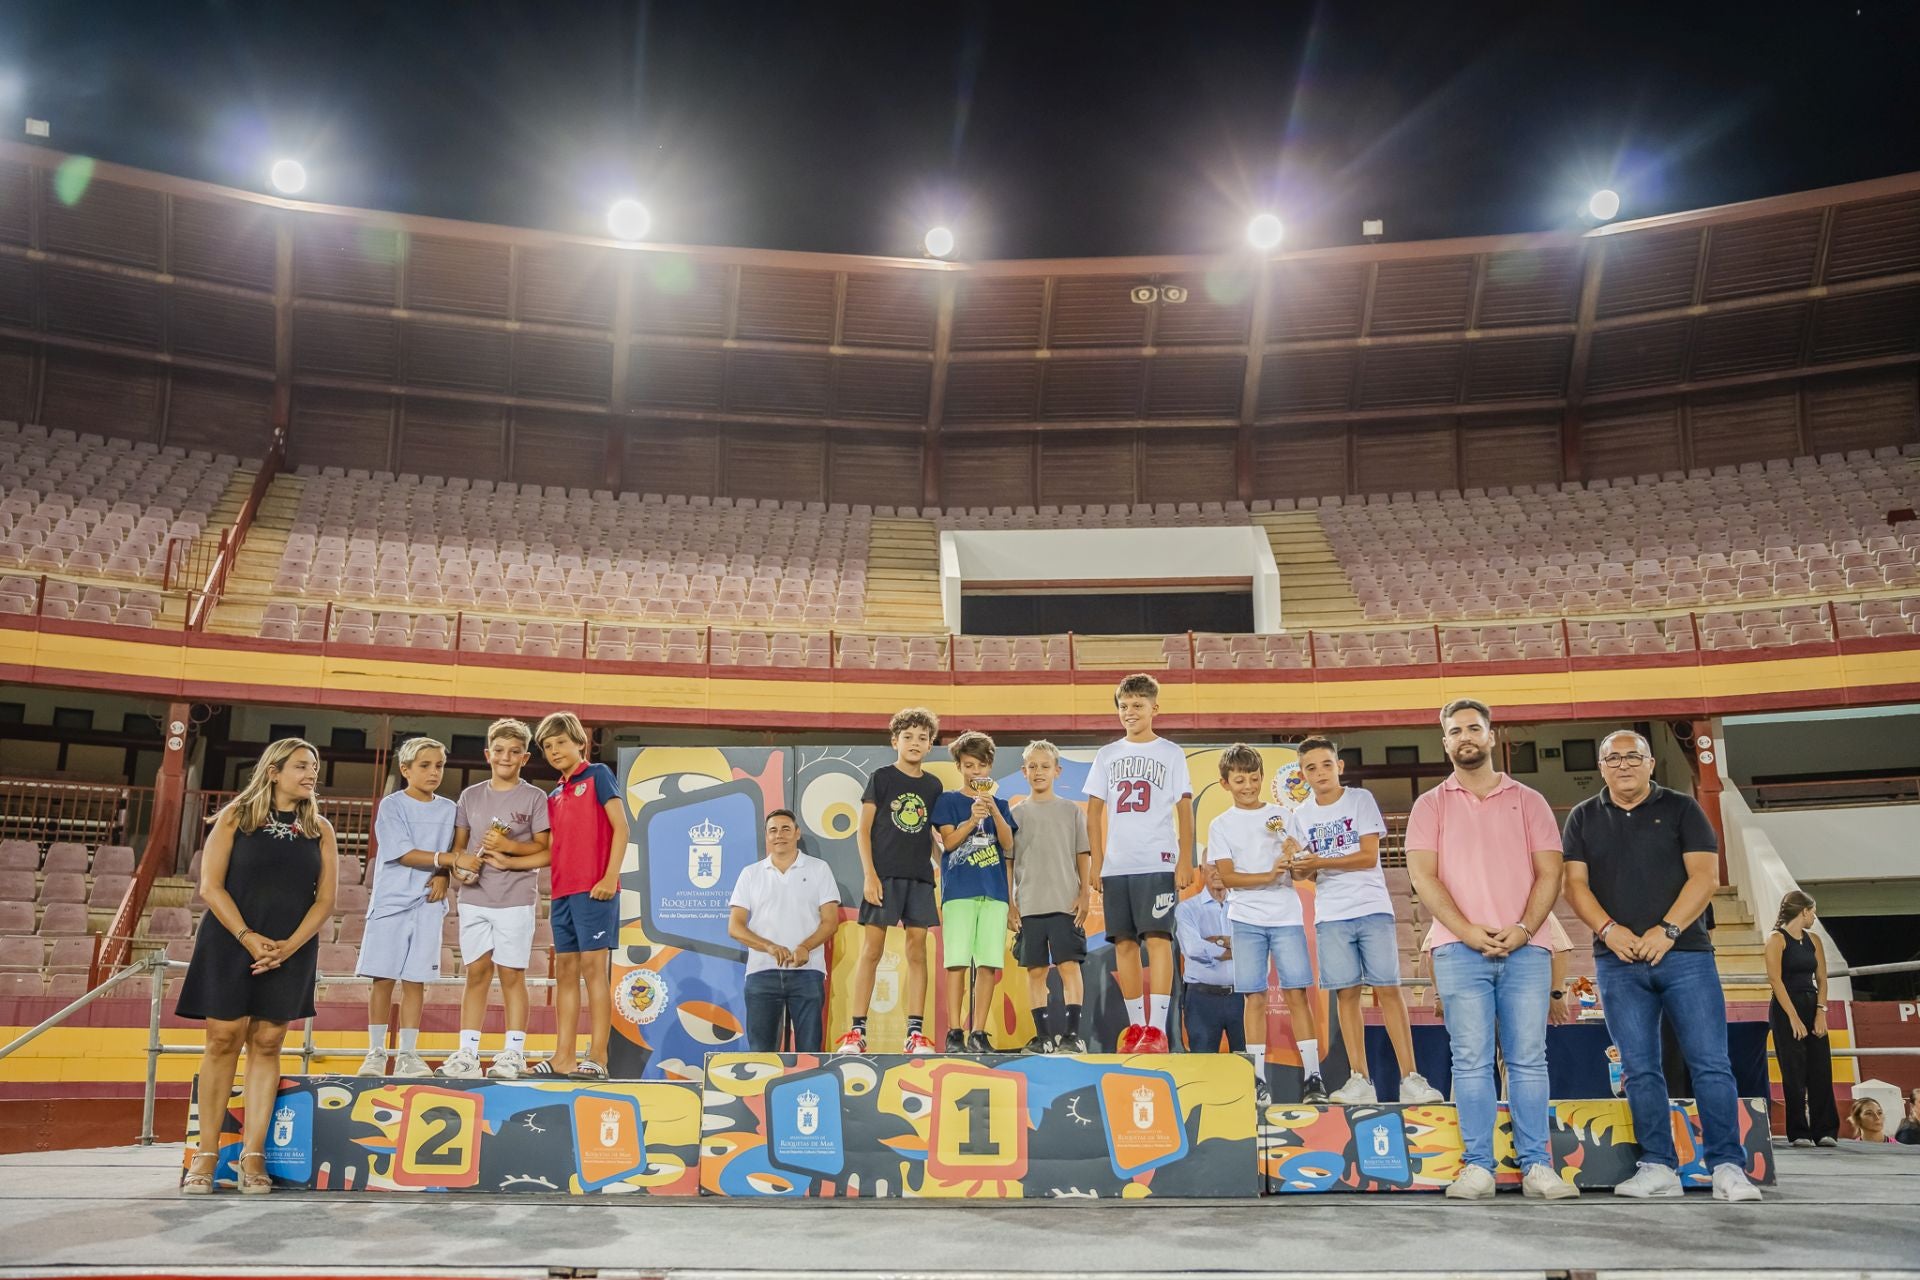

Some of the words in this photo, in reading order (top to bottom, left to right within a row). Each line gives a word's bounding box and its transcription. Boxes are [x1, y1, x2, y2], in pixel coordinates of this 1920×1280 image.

[1109, 756, 1167, 790] JORDAN
[1116, 780, 1151, 814] 23
[1308, 817, 1353, 840] TOMMY
[1309, 830, 1360, 853] ILFIGER
[967, 844, 998, 866] SAVAGE
[1155, 893, 1175, 909] NIKE
[1899, 1003, 1920, 1022] P
[955, 1088, 999, 1155] 1
[415, 1106, 462, 1165] 2
